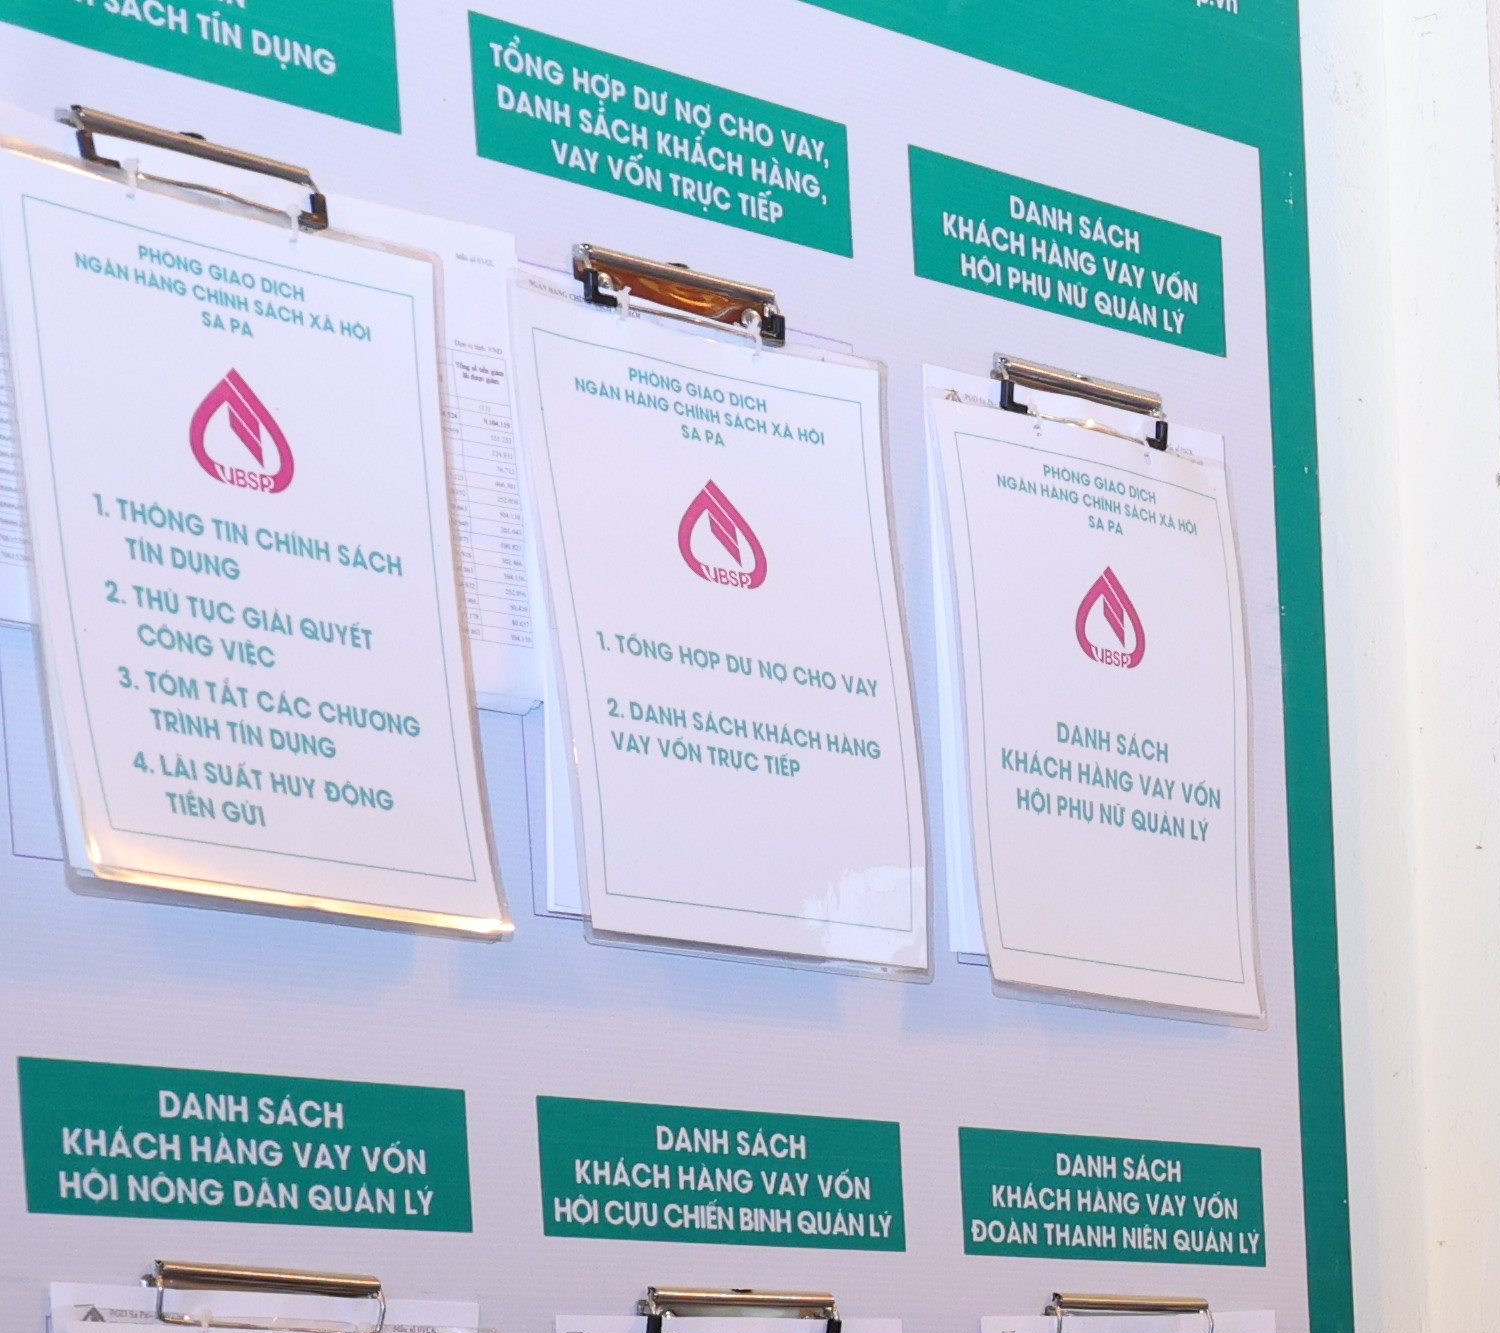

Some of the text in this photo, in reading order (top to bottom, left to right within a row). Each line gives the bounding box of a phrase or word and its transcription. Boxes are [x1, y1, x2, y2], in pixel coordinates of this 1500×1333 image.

[197, 11, 243, 50] TÍN
[251, 28, 337, 75] DỤNG
[489, 35, 829, 169] TỔNG HỢP DƯ NỢ CHO VAY,
[496, 83, 827, 206] DANH SÁCH KHÁCH HÀNG,
[551, 138, 784, 224] VAY VỐN TRỰC TIẾP
[1009, 194, 1140, 254] DANH SÁCH
[942, 211, 1198, 305] KHÁCH HÀNG VAY VỐN
[93, 493, 403, 577] 1. THÔNG TIN CHÍNH SÁCH
[124, 537, 241, 581] TÍN DỤNG
[104, 580, 126, 605] 2.
[186, 595, 236, 625] TỤC
[299, 617, 373, 650] QUYẾT
[136, 623, 276, 669] CÔNG VIỆC
[117, 665, 139, 690] 3.
[144, 670, 199, 700] TÓM
[256, 690, 312, 719] CÁC
[318, 701, 421, 738] CHƯƠNG
[149, 708, 337, 759] TRÌNH TÍN DỤNG
[133, 751, 155, 774] 4.
[203, 761, 263, 791] SUẤT
[269, 772, 316, 799] HUY
[324, 780, 394, 812] ĐỘNG
[158, 1090, 344, 1129] DANH SÁCH
[62, 1126, 427, 1175] KHÁCH HÀNG VAY VỐN
[656, 1125, 807, 1160] DANH SÁCH
[1056, 1152, 1182, 1183] DANH SÁCH
[127, 1171, 225, 1206] NÔNG
[575, 1157, 871, 1200] KHÁCH HÀNG VAY VỐN
[991, 1183, 1239, 1220] KHÁCH HÀNG VAY VỐN
[663, 1199, 735, 1230] CHIẾN
[1043, 1222, 1117, 1248] THANH
